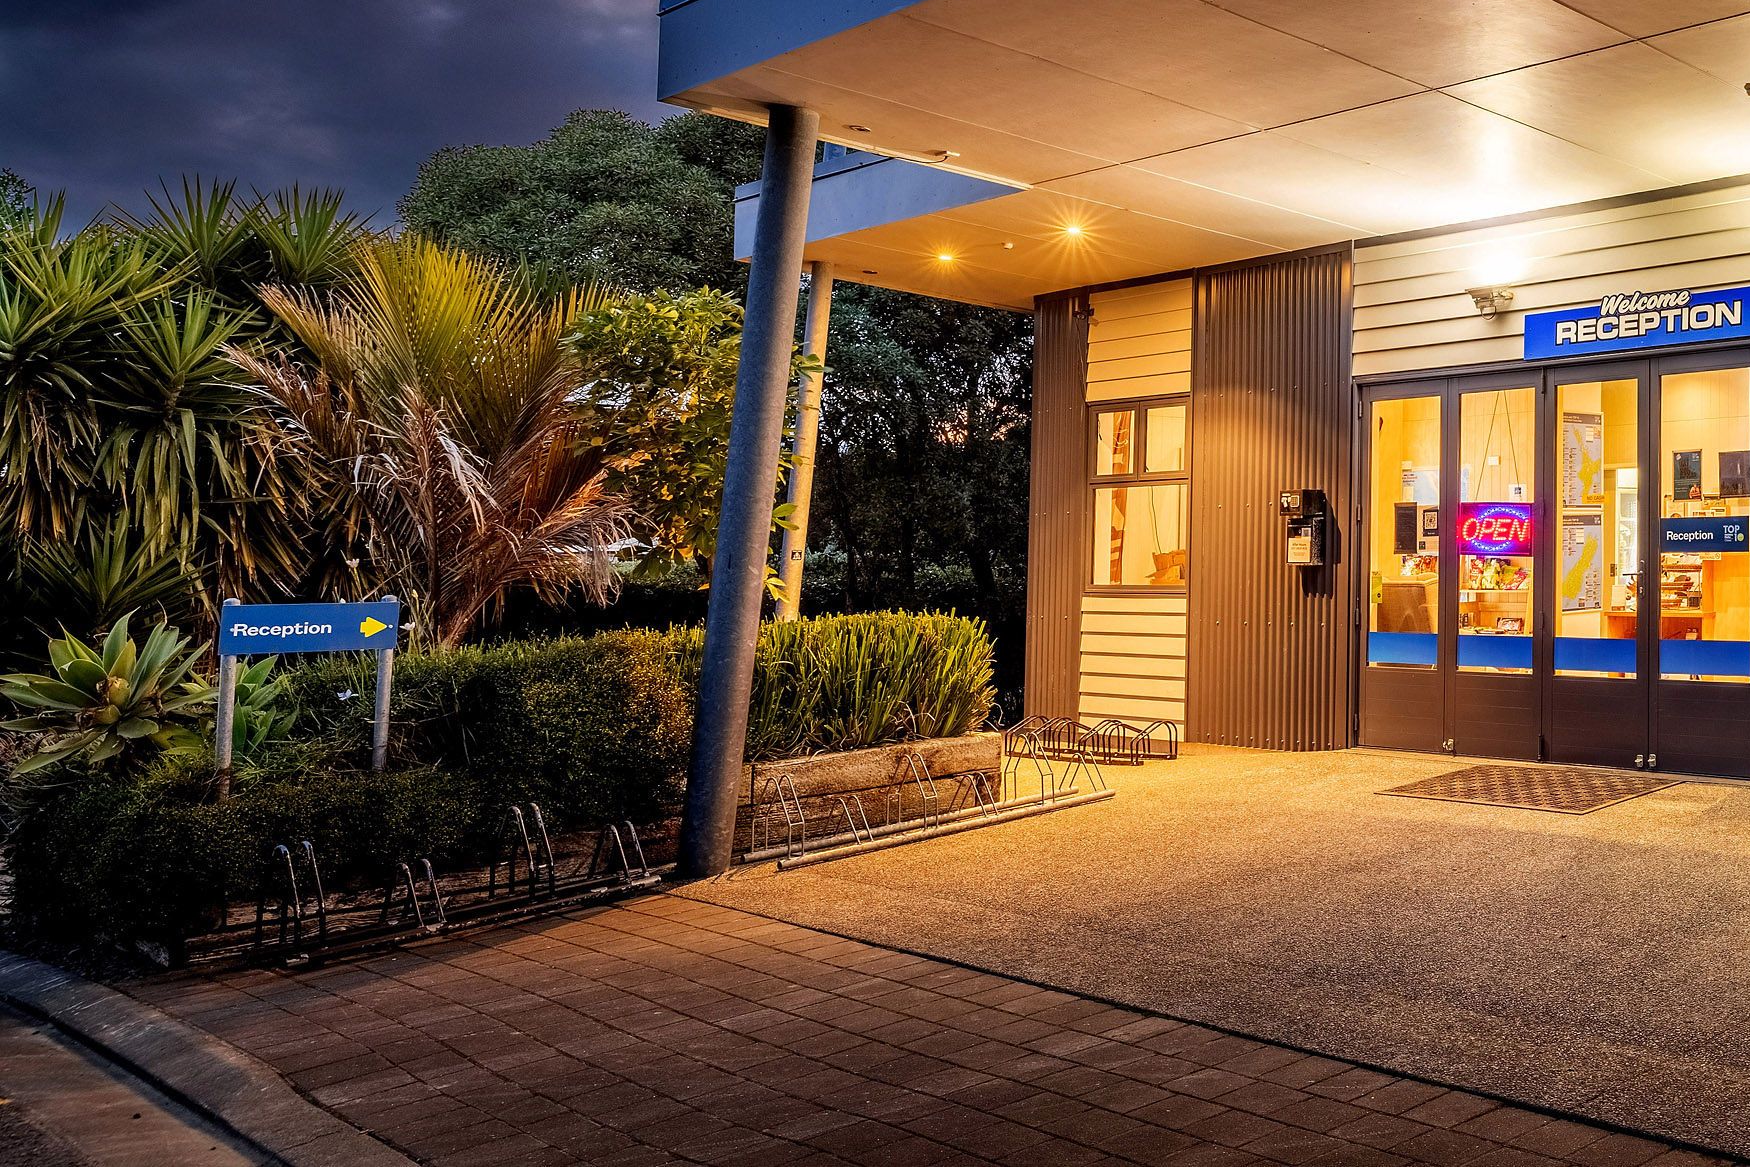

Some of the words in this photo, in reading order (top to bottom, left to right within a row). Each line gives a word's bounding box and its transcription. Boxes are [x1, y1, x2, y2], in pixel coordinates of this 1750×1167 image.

[1600, 290, 1692, 316] Welcome
[1555, 300, 1741, 346] RECEPTION
[1462, 518, 1530, 542] OPEN
[1666, 530, 1714, 542] Reception
[1723, 524, 1740, 533] TOP
[232, 622, 332, 638] Reception
